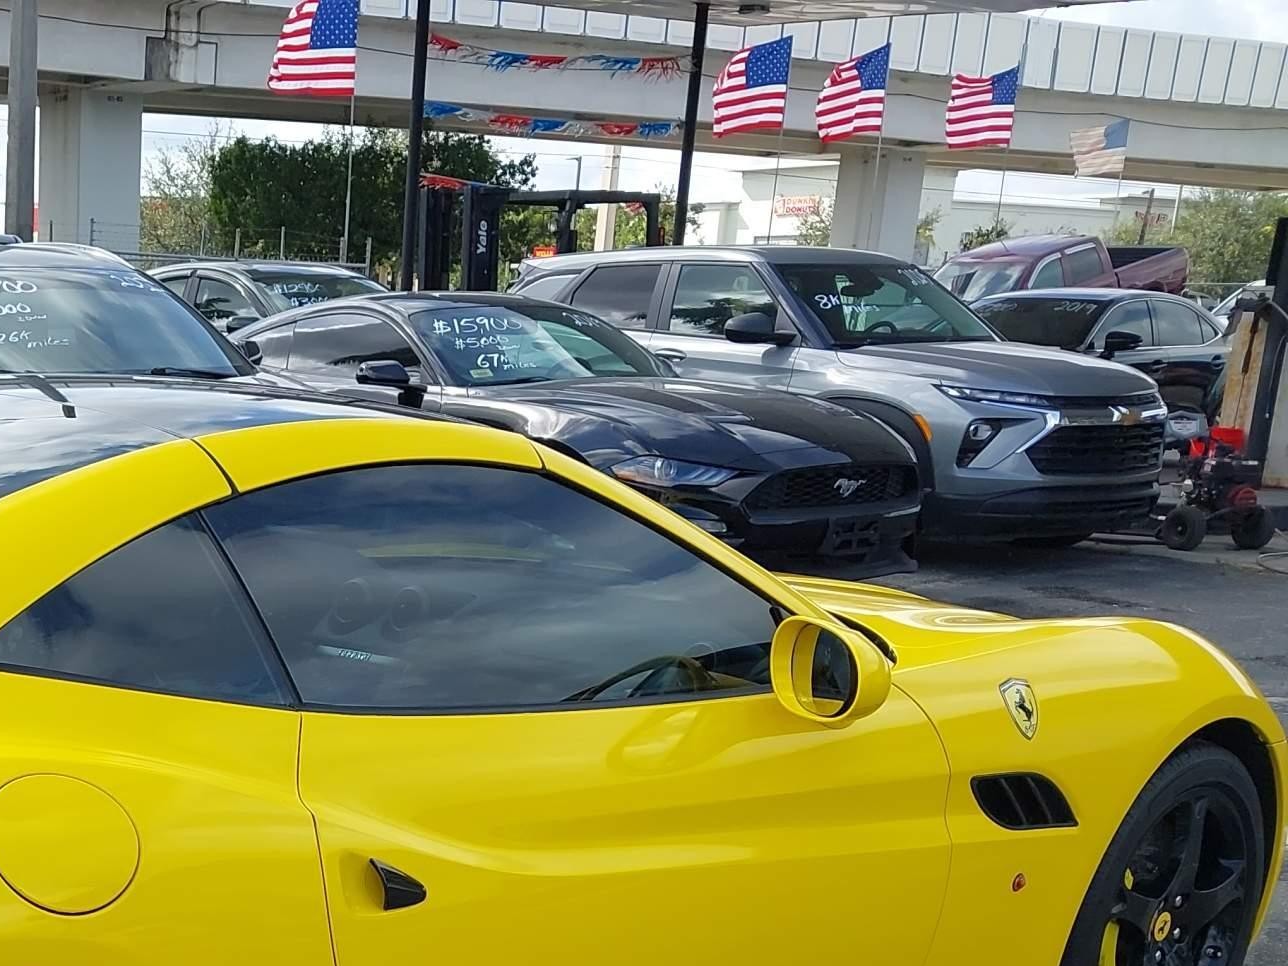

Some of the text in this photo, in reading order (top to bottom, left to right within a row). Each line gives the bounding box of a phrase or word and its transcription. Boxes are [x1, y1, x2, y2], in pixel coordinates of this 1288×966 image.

[476, 220, 488, 255] Yale
[814, 294, 841, 309] 8K
[1053, 301, 1098, 315] 2019
[432, 316, 522, 336] $15,900
[454, 335, 510, 351] $5,000
